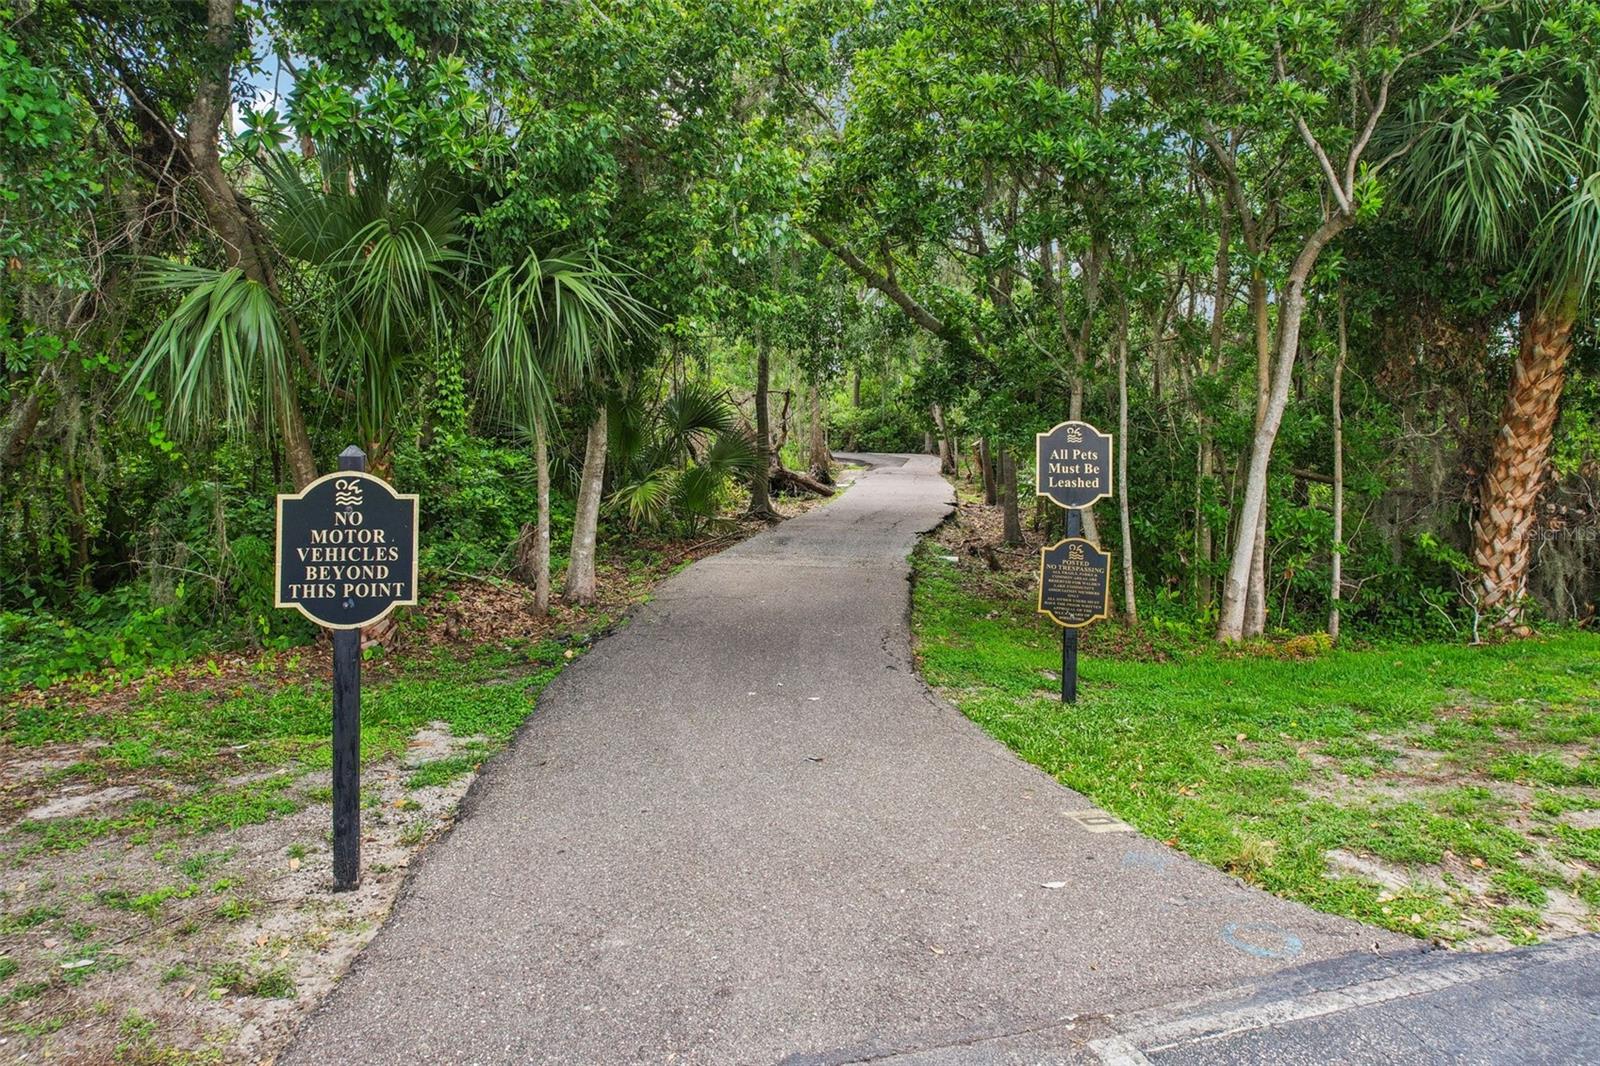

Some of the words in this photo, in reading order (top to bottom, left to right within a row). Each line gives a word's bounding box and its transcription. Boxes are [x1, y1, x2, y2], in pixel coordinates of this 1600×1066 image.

[1050, 449, 1068, 460] All
[1072, 449, 1098, 460] Pets
[1048, 463, 1080, 474] Must
[1084, 463, 1100, 474] Be
[1048, 477, 1100, 488] Leashed
[334, 511, 363, 526] NO
[310, 529, 386, 544] MOTOR
[296, 546, 399, 562] VEHICLES
[306, 565, 390, 581] BEYOND
[1058, 564, 1104, 574] TRESPASSING
[288, 583, 336, 599] THIS
[343, 582, 405, 598] POINT
